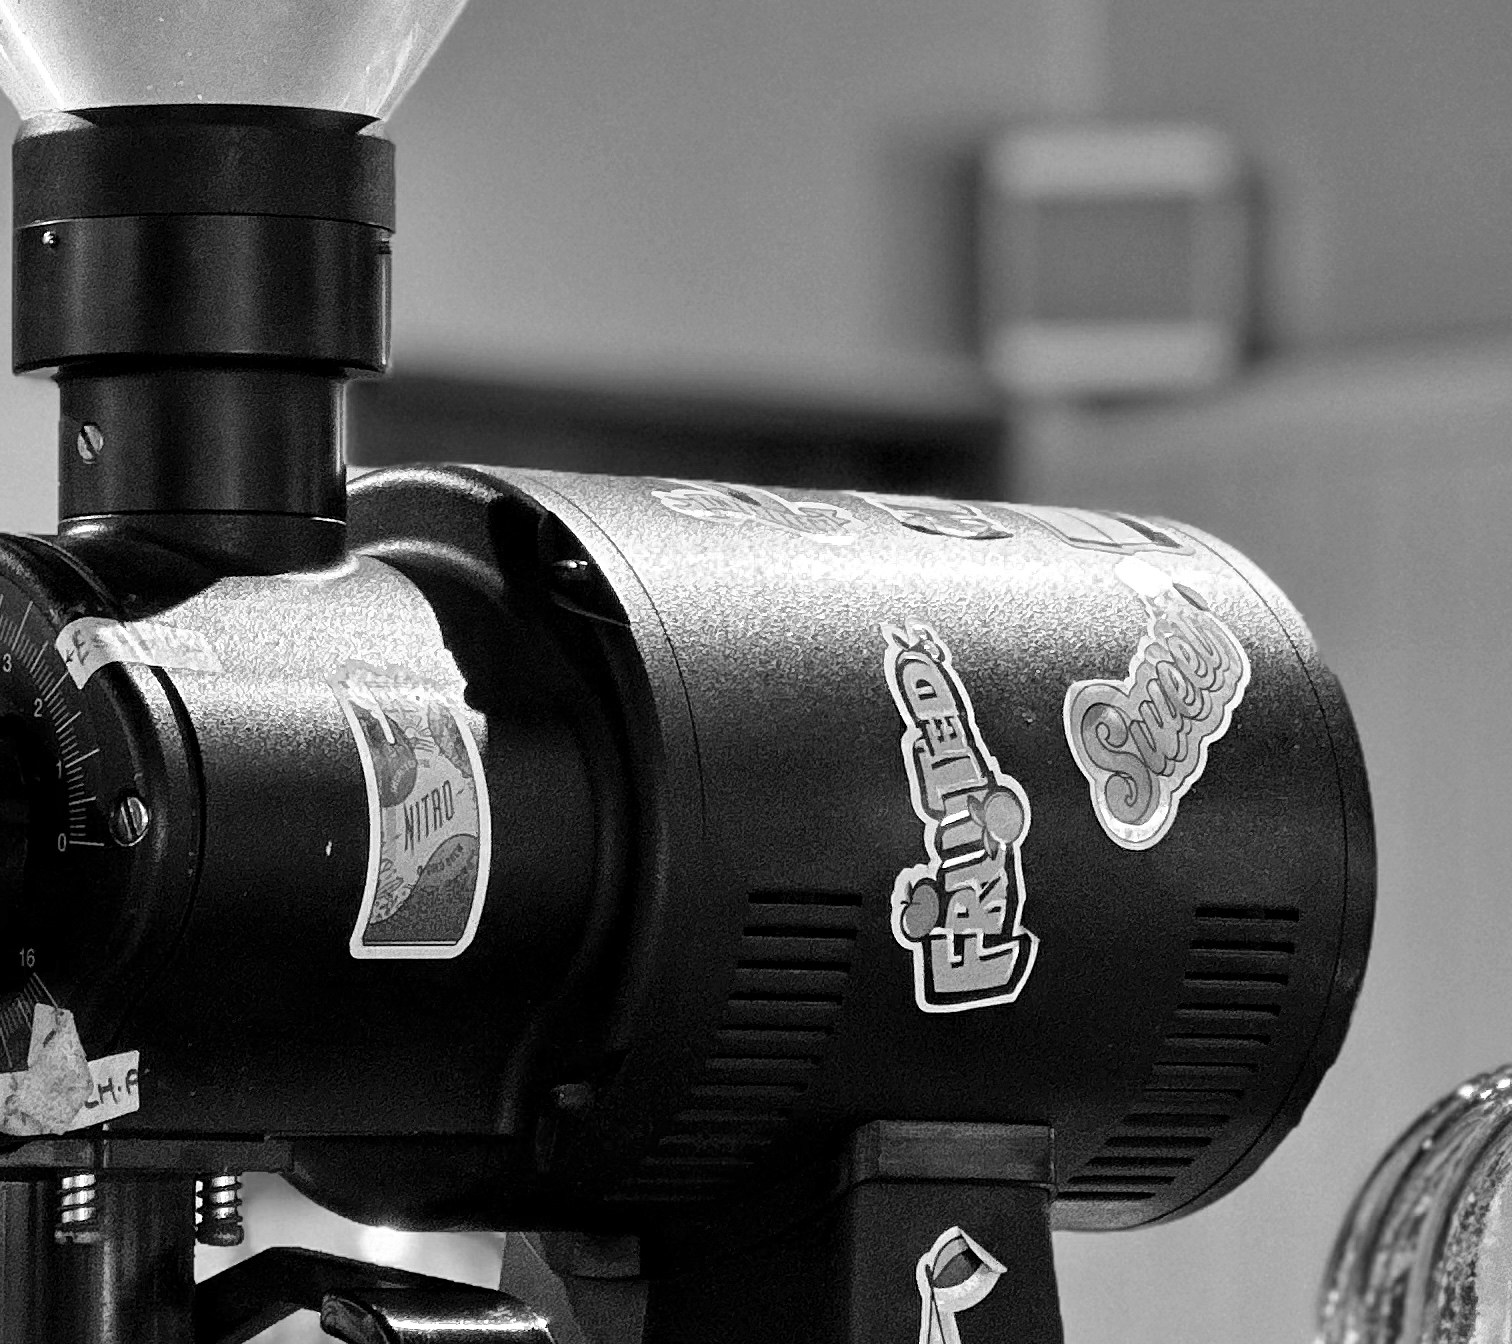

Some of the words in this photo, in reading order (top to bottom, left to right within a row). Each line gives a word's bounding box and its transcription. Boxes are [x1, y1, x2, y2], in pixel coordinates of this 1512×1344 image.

[1, 653, 12, 673] 3
[33, 697, 43, 718] 2
[1080, 611, 1226, 827] Sweet
[55, 759, 63, 779] 1
[402, 779, 456, 853] NITRO
[56, 832, 67, 852] 0
[19, 947, 36, 968] 16
